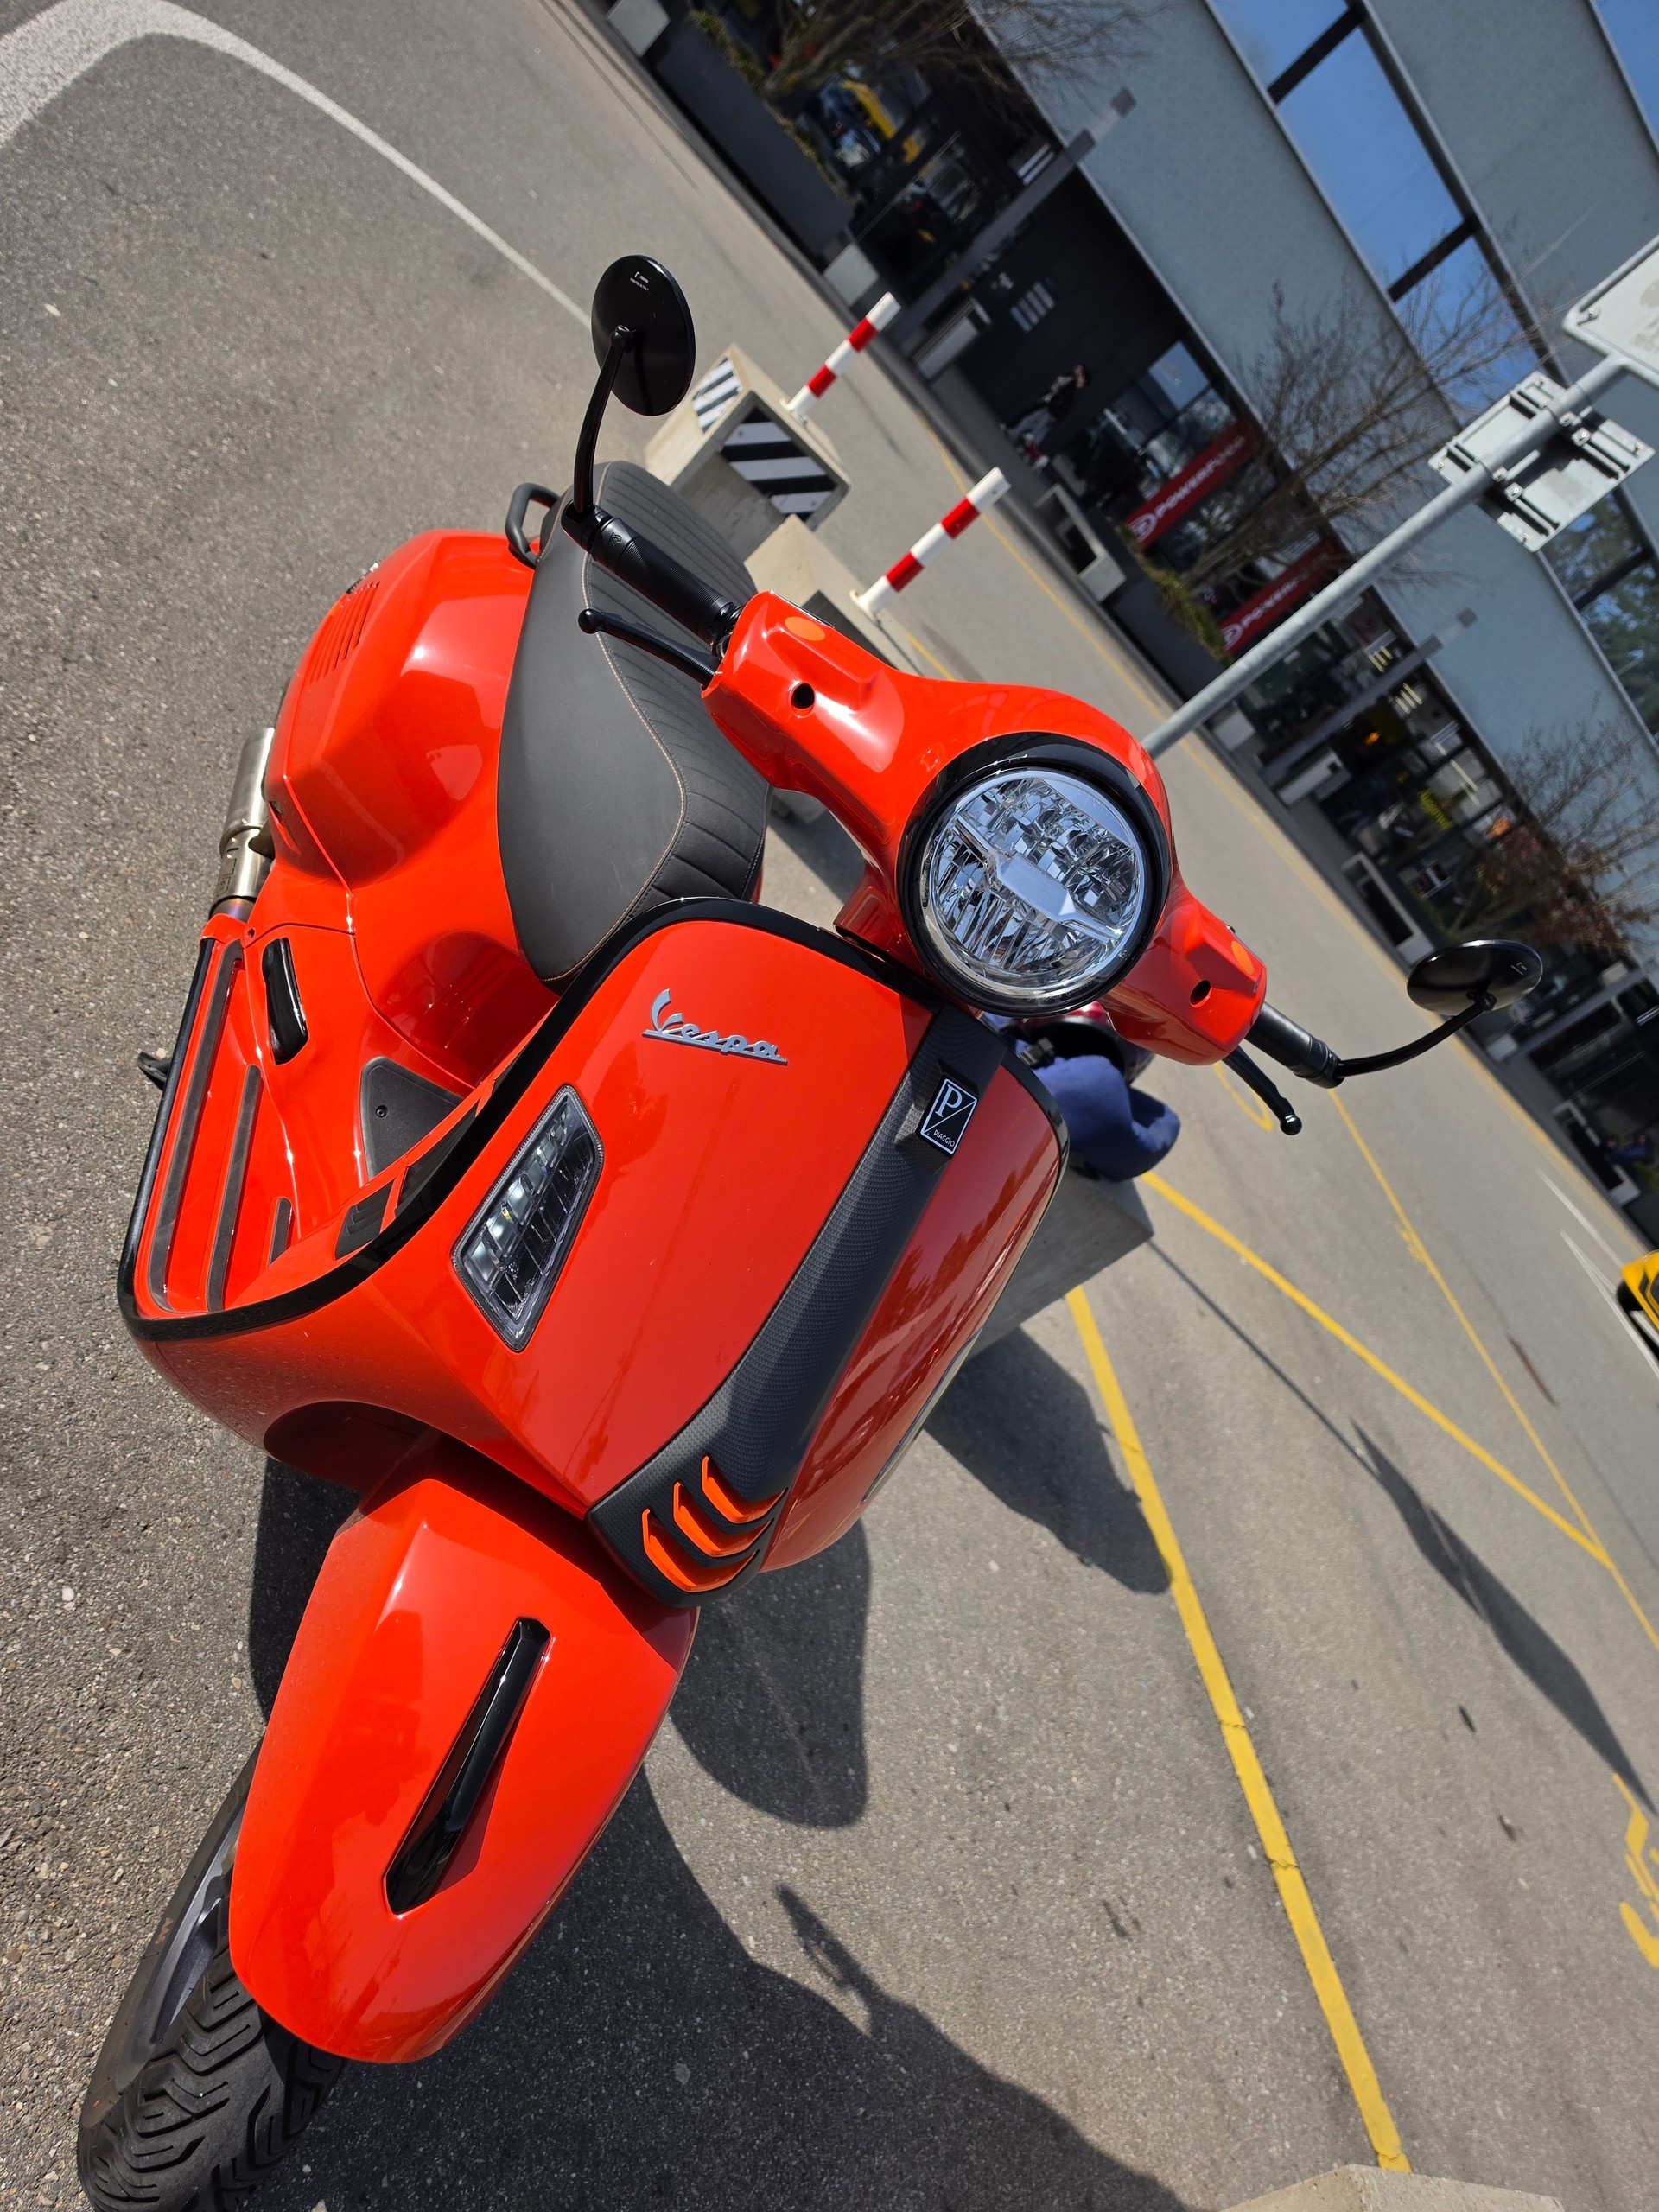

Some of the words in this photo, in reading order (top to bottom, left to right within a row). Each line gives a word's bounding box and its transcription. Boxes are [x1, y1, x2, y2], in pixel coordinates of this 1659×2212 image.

[642, 988, 787, 1065] Vespa
[935, 1084, 963, 1117] P
[933, 1129, 956, 1147] PIAGGIO
